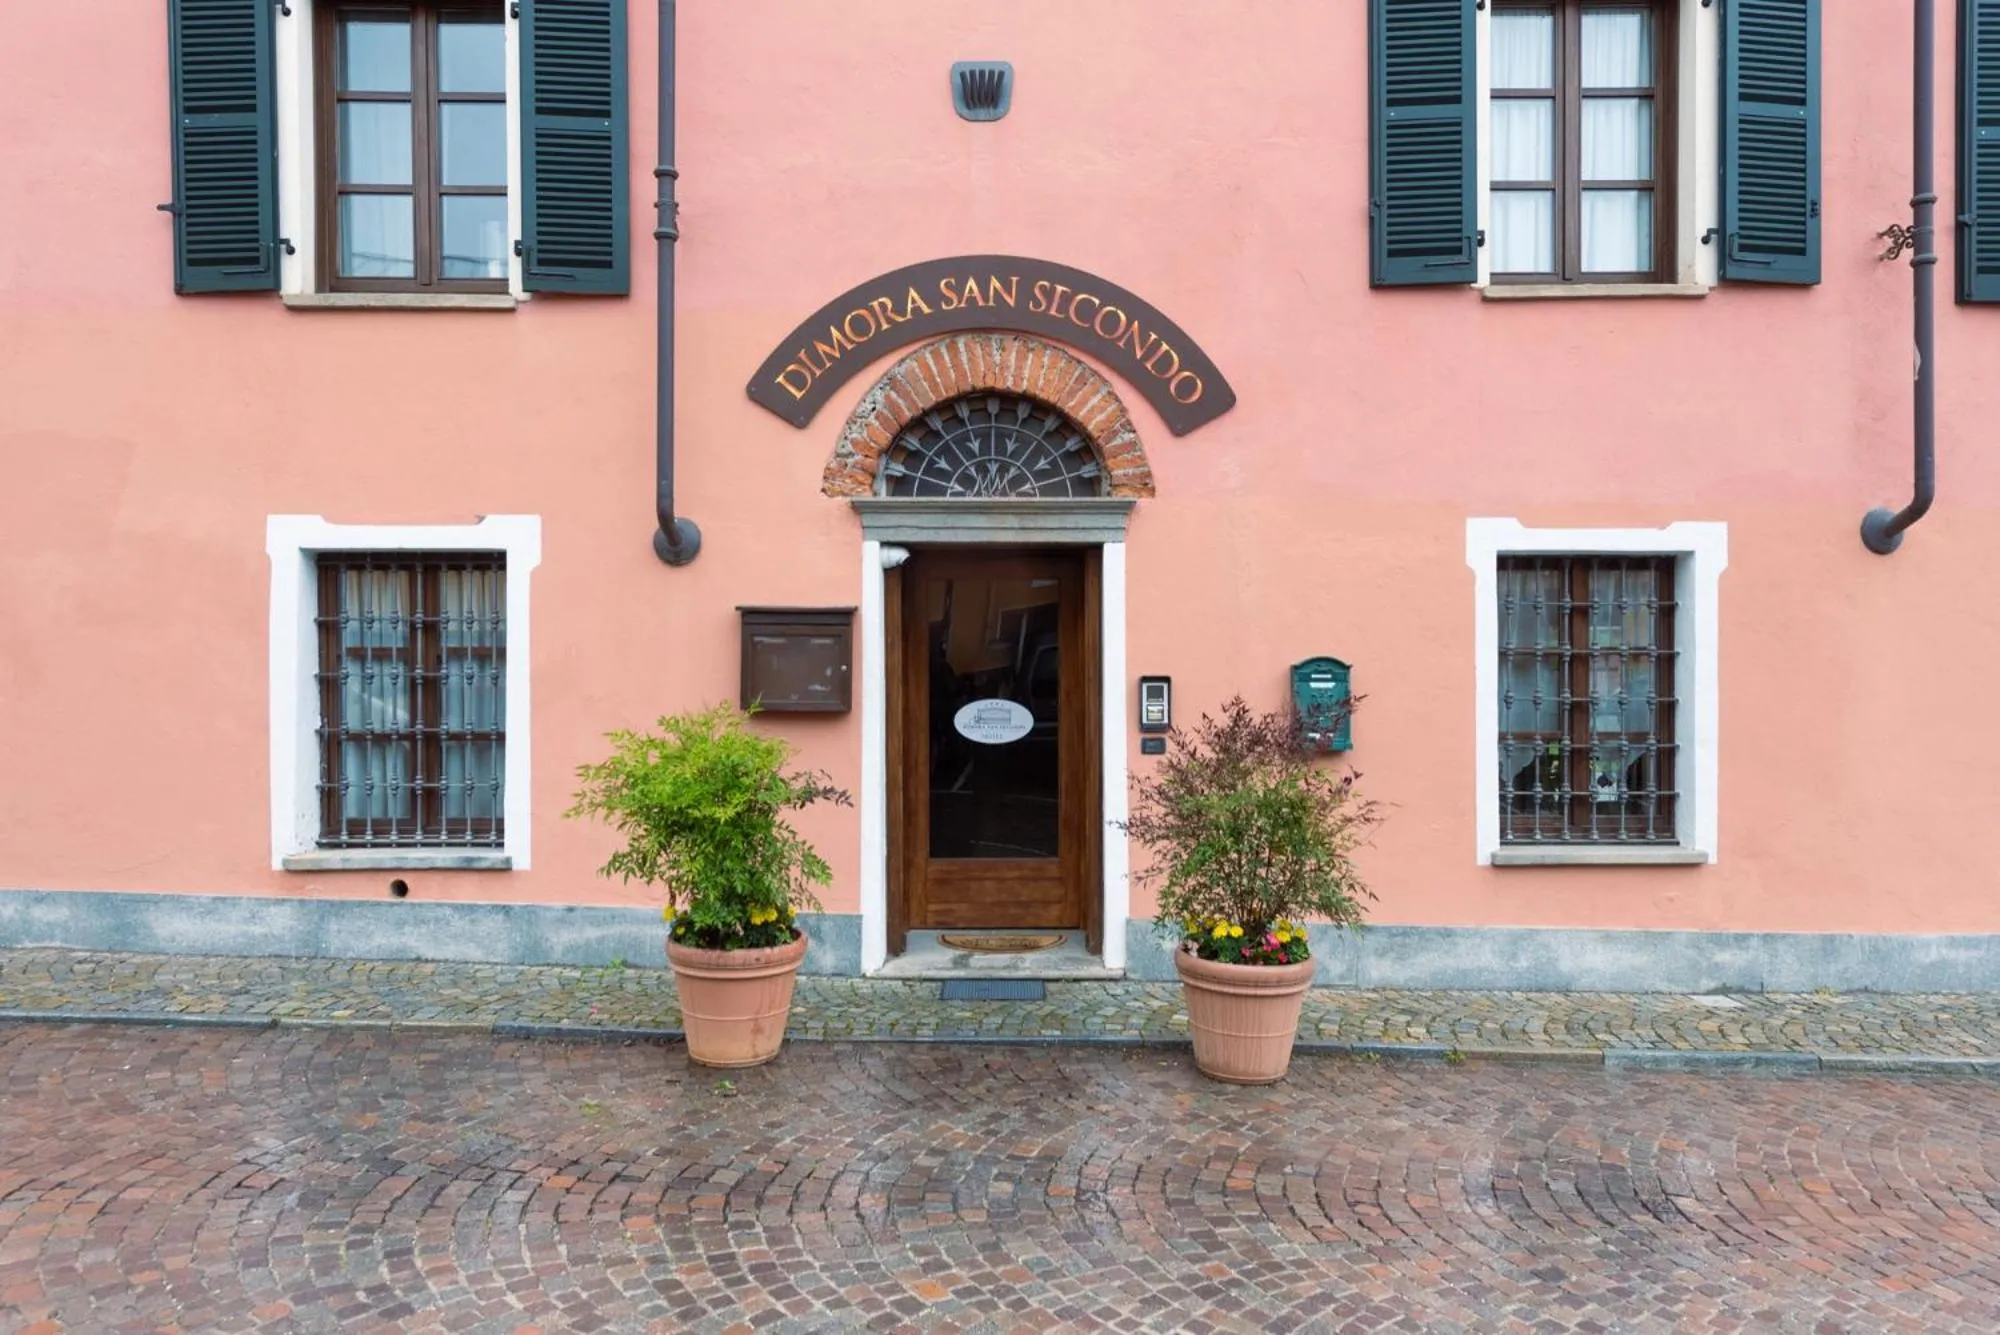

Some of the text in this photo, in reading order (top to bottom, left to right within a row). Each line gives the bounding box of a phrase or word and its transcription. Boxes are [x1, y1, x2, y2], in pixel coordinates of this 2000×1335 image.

[774, 276, 1203, 404] DIMORA SAN SECONDO
